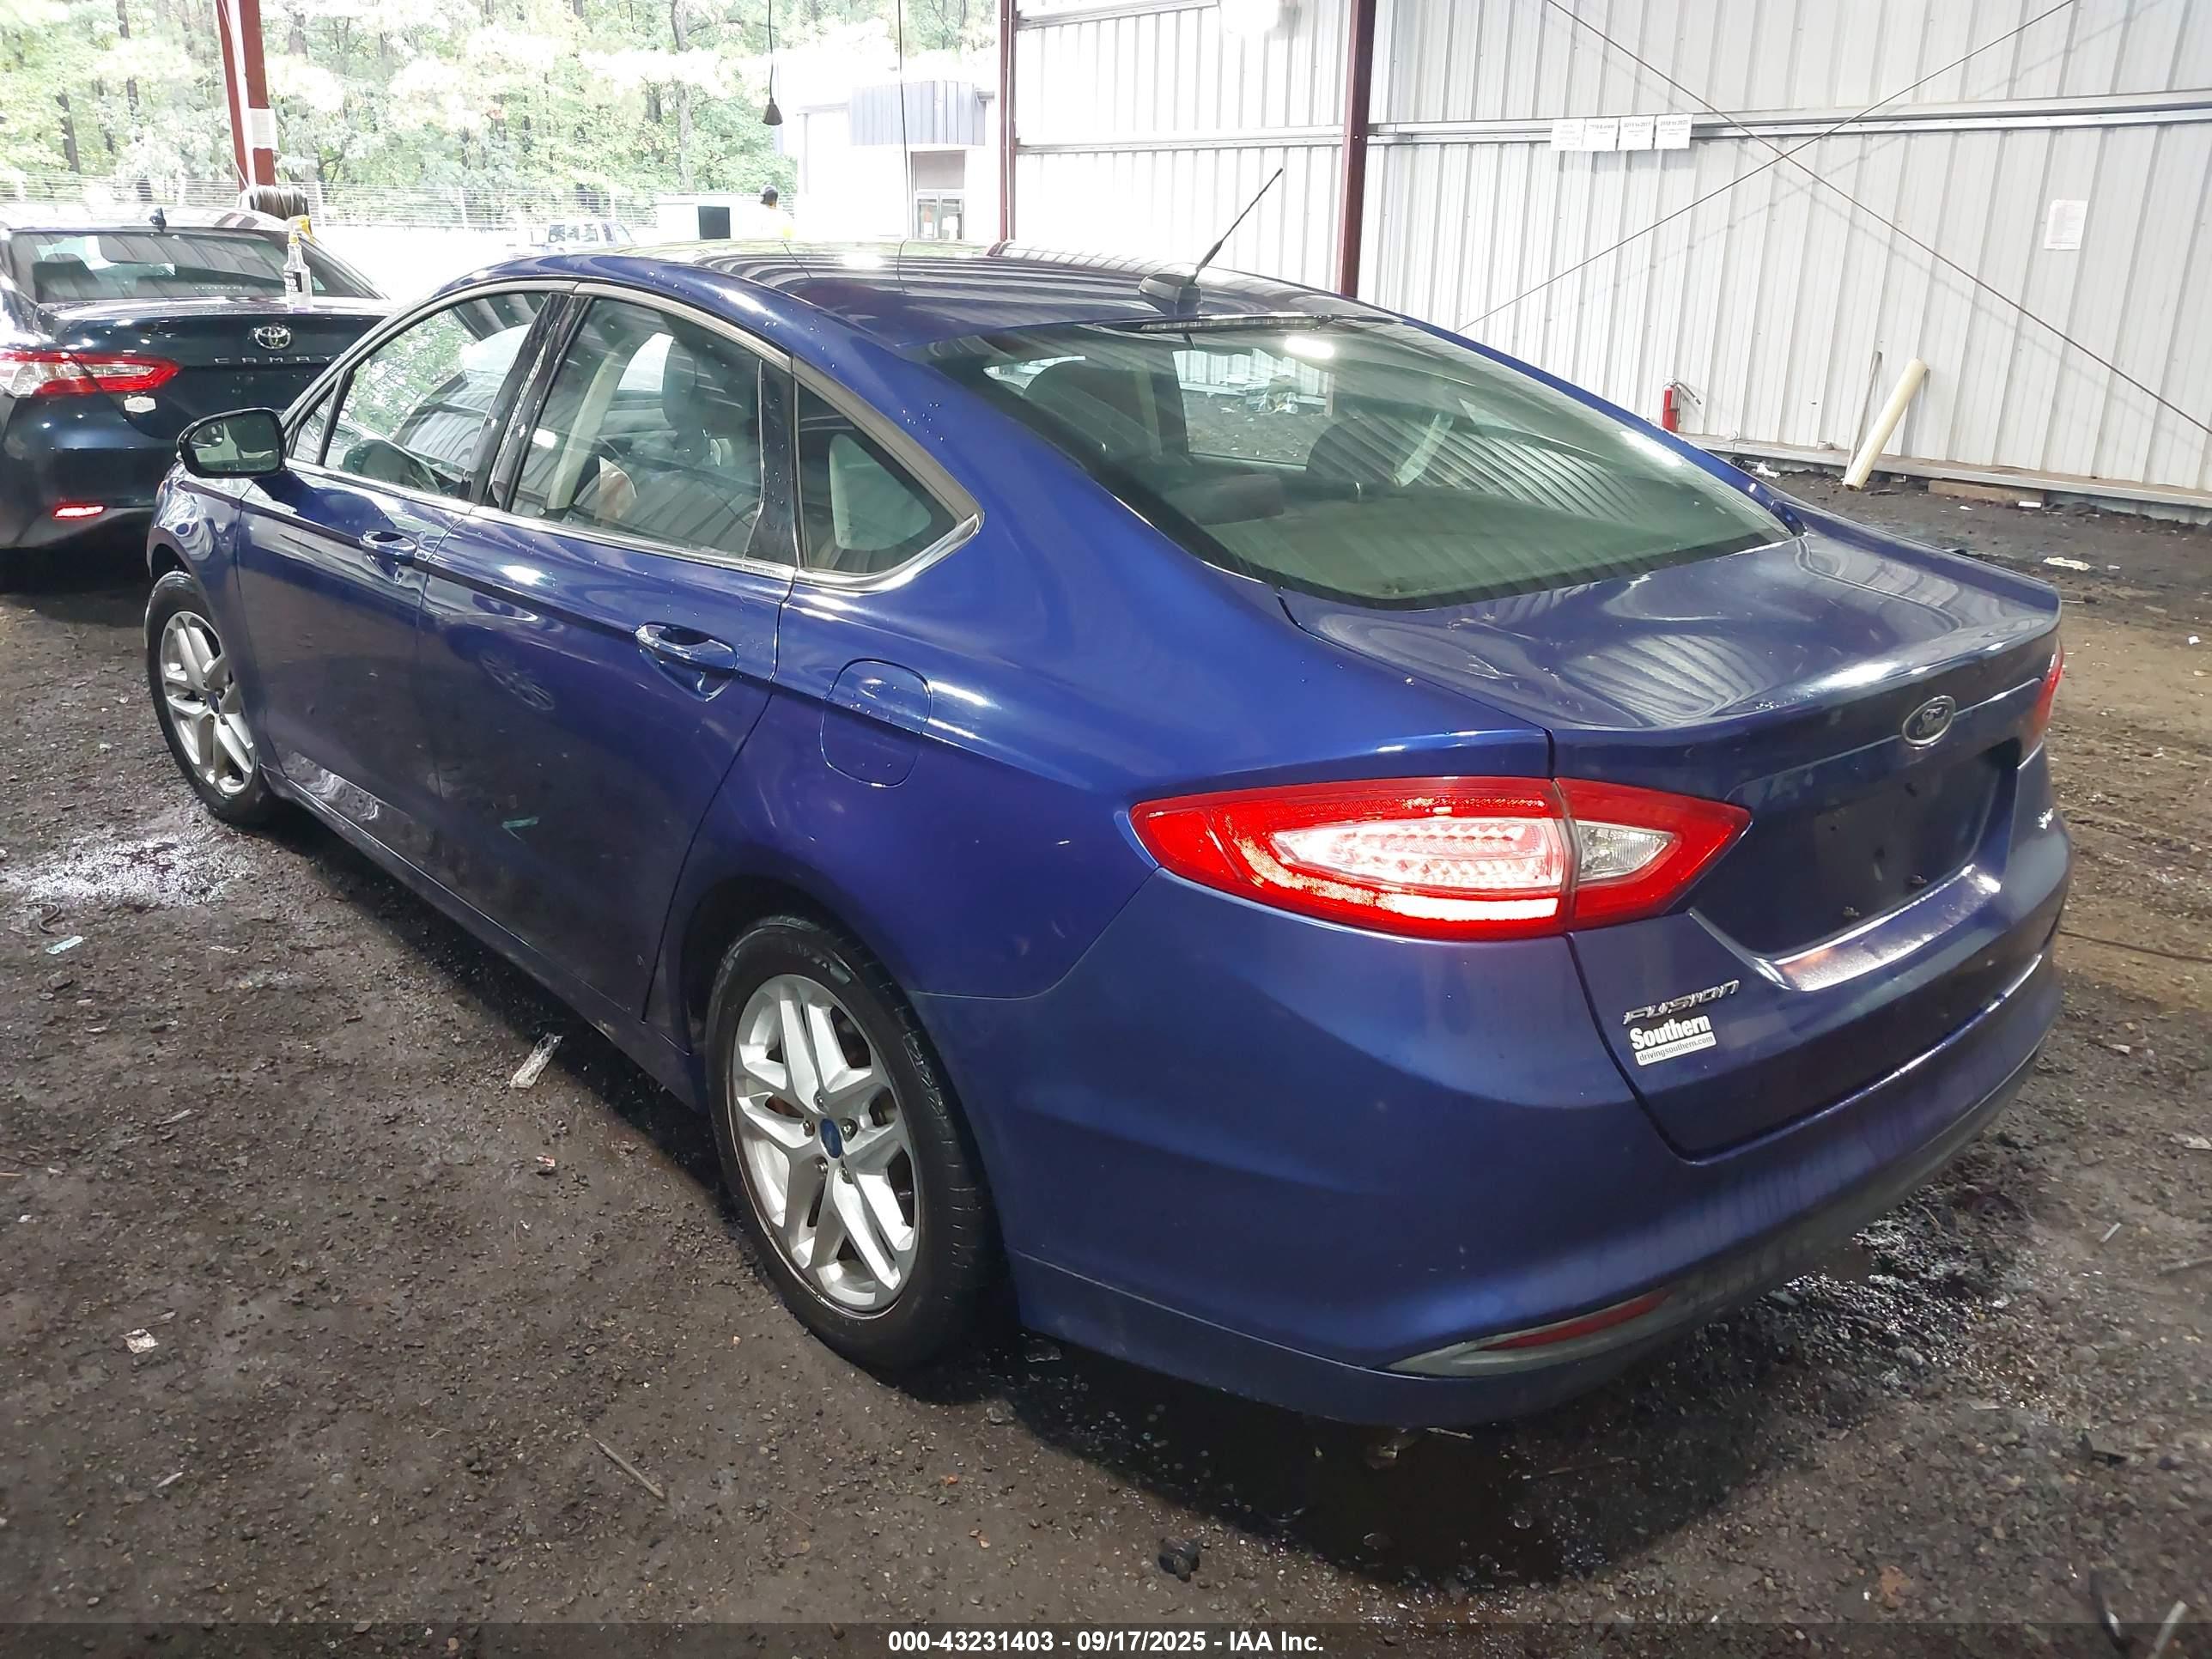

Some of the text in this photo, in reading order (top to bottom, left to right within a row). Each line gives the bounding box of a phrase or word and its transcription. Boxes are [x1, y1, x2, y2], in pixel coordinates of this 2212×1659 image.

[1622, 979, 1740, 1024] FUSION
[1630, 1015, 1711, 1050] Southern
[1639, 1036, 1714, 1061] drivingsouthern.com
